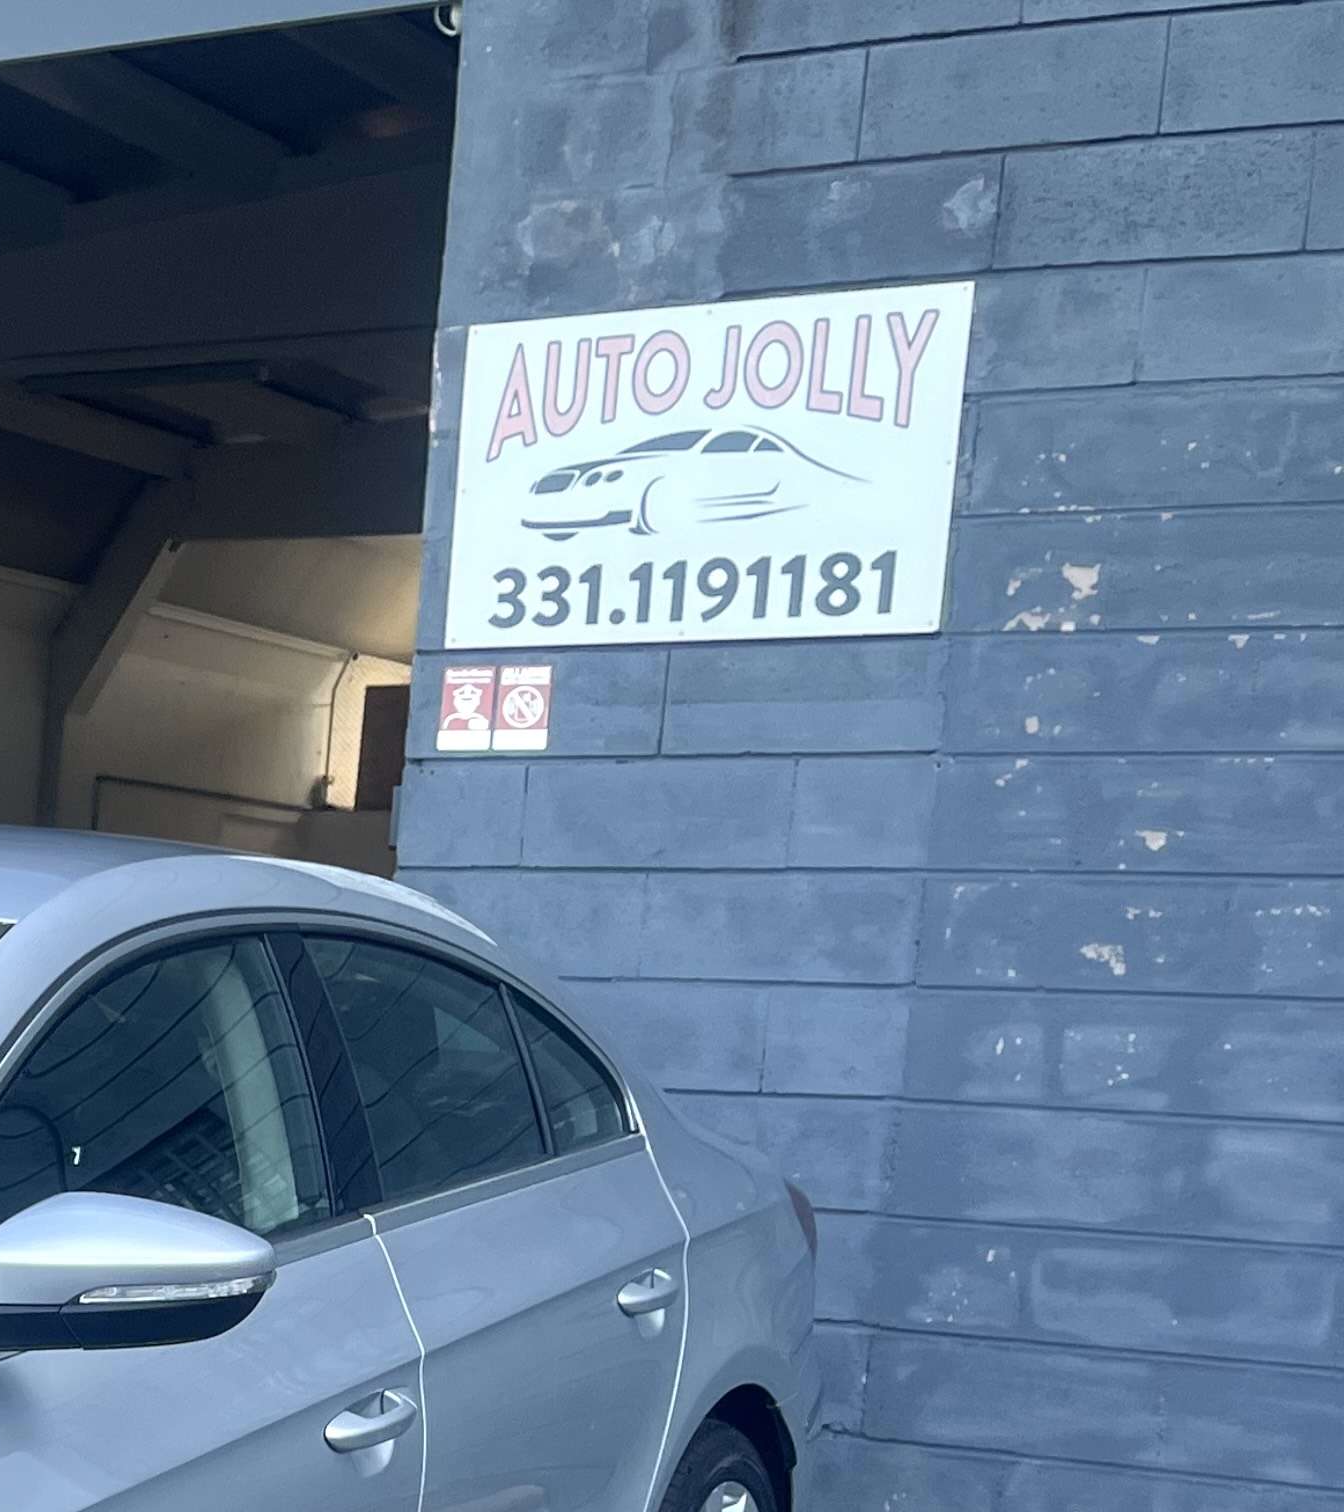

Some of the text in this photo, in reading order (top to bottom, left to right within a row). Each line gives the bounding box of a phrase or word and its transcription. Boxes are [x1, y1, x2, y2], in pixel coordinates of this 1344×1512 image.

[486, 308, 941, 463] AUTO JOLLY
[487, 550, 899, 629] 331.1191181
